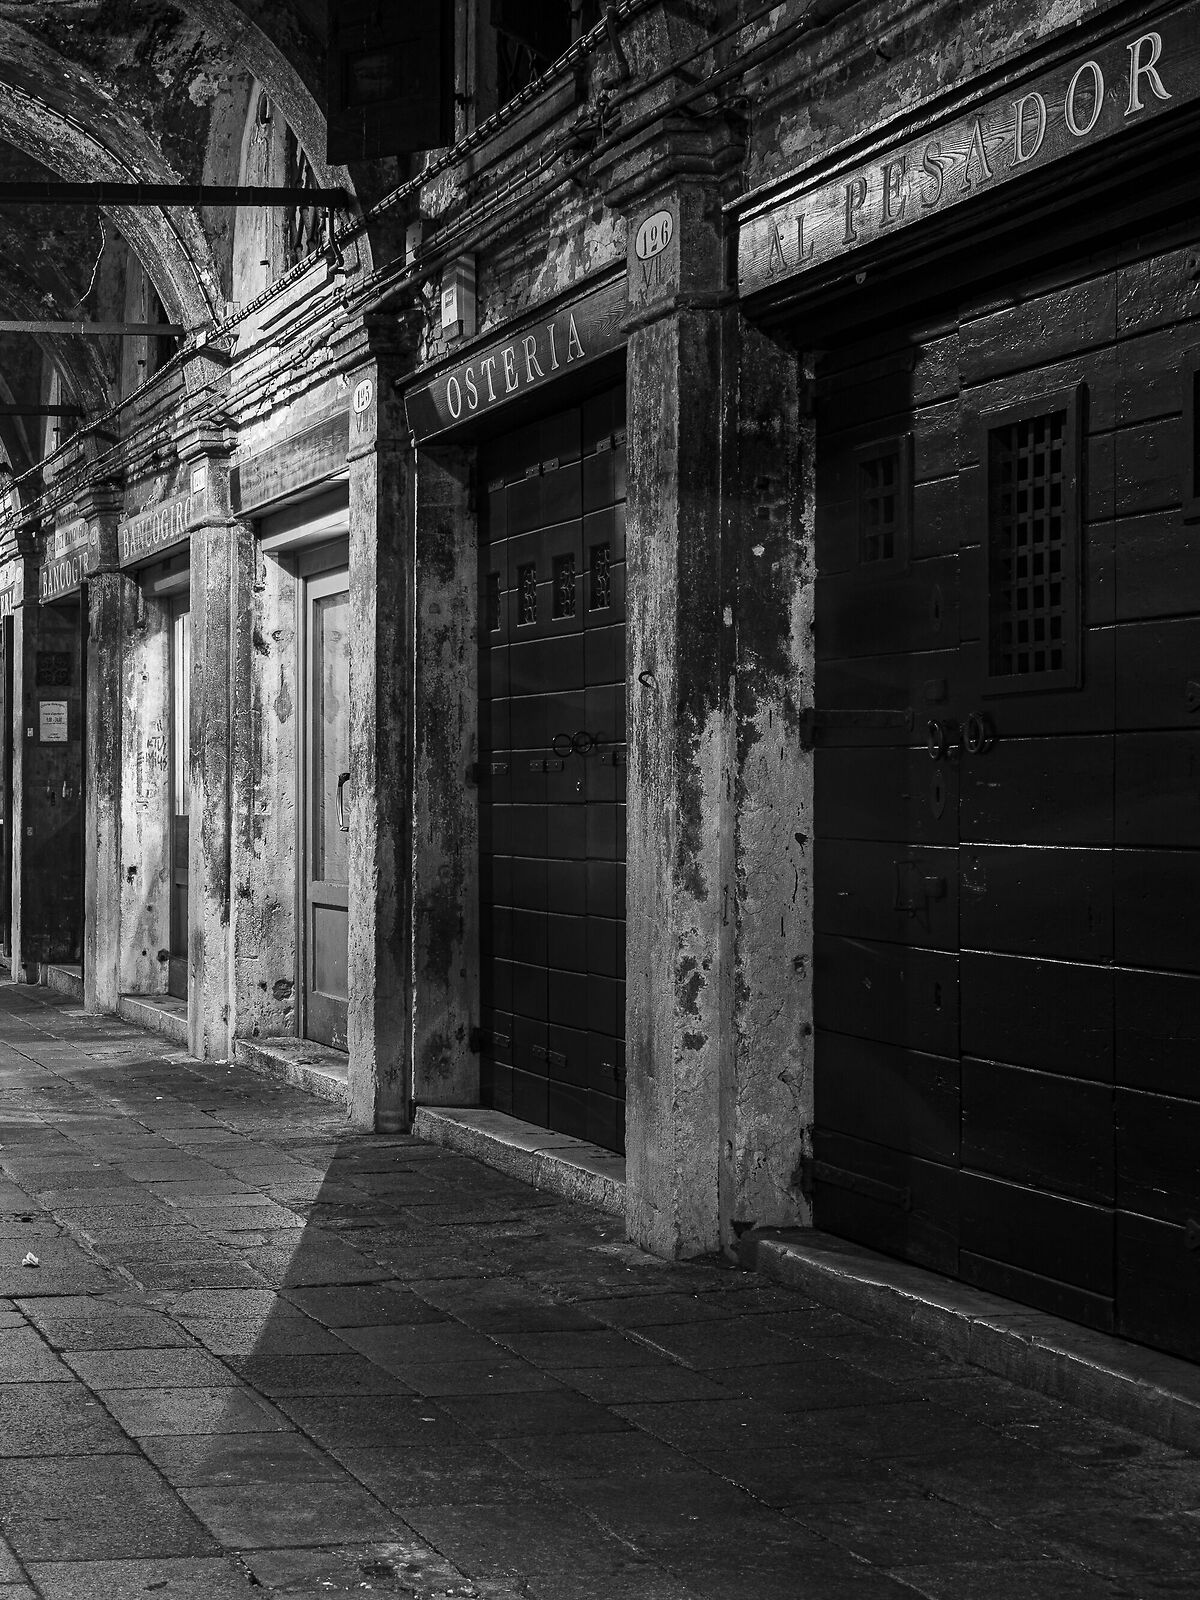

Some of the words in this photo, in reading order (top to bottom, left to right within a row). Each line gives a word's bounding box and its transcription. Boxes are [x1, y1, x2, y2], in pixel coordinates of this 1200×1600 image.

[766, 212, 815, 280] AL
[842, 31, 1173, 246] PESADOR
[643, 219, 669, 257] 126
[357, 385, 370, 408] 125
[446, 312, 586, 419] OSTERIA
